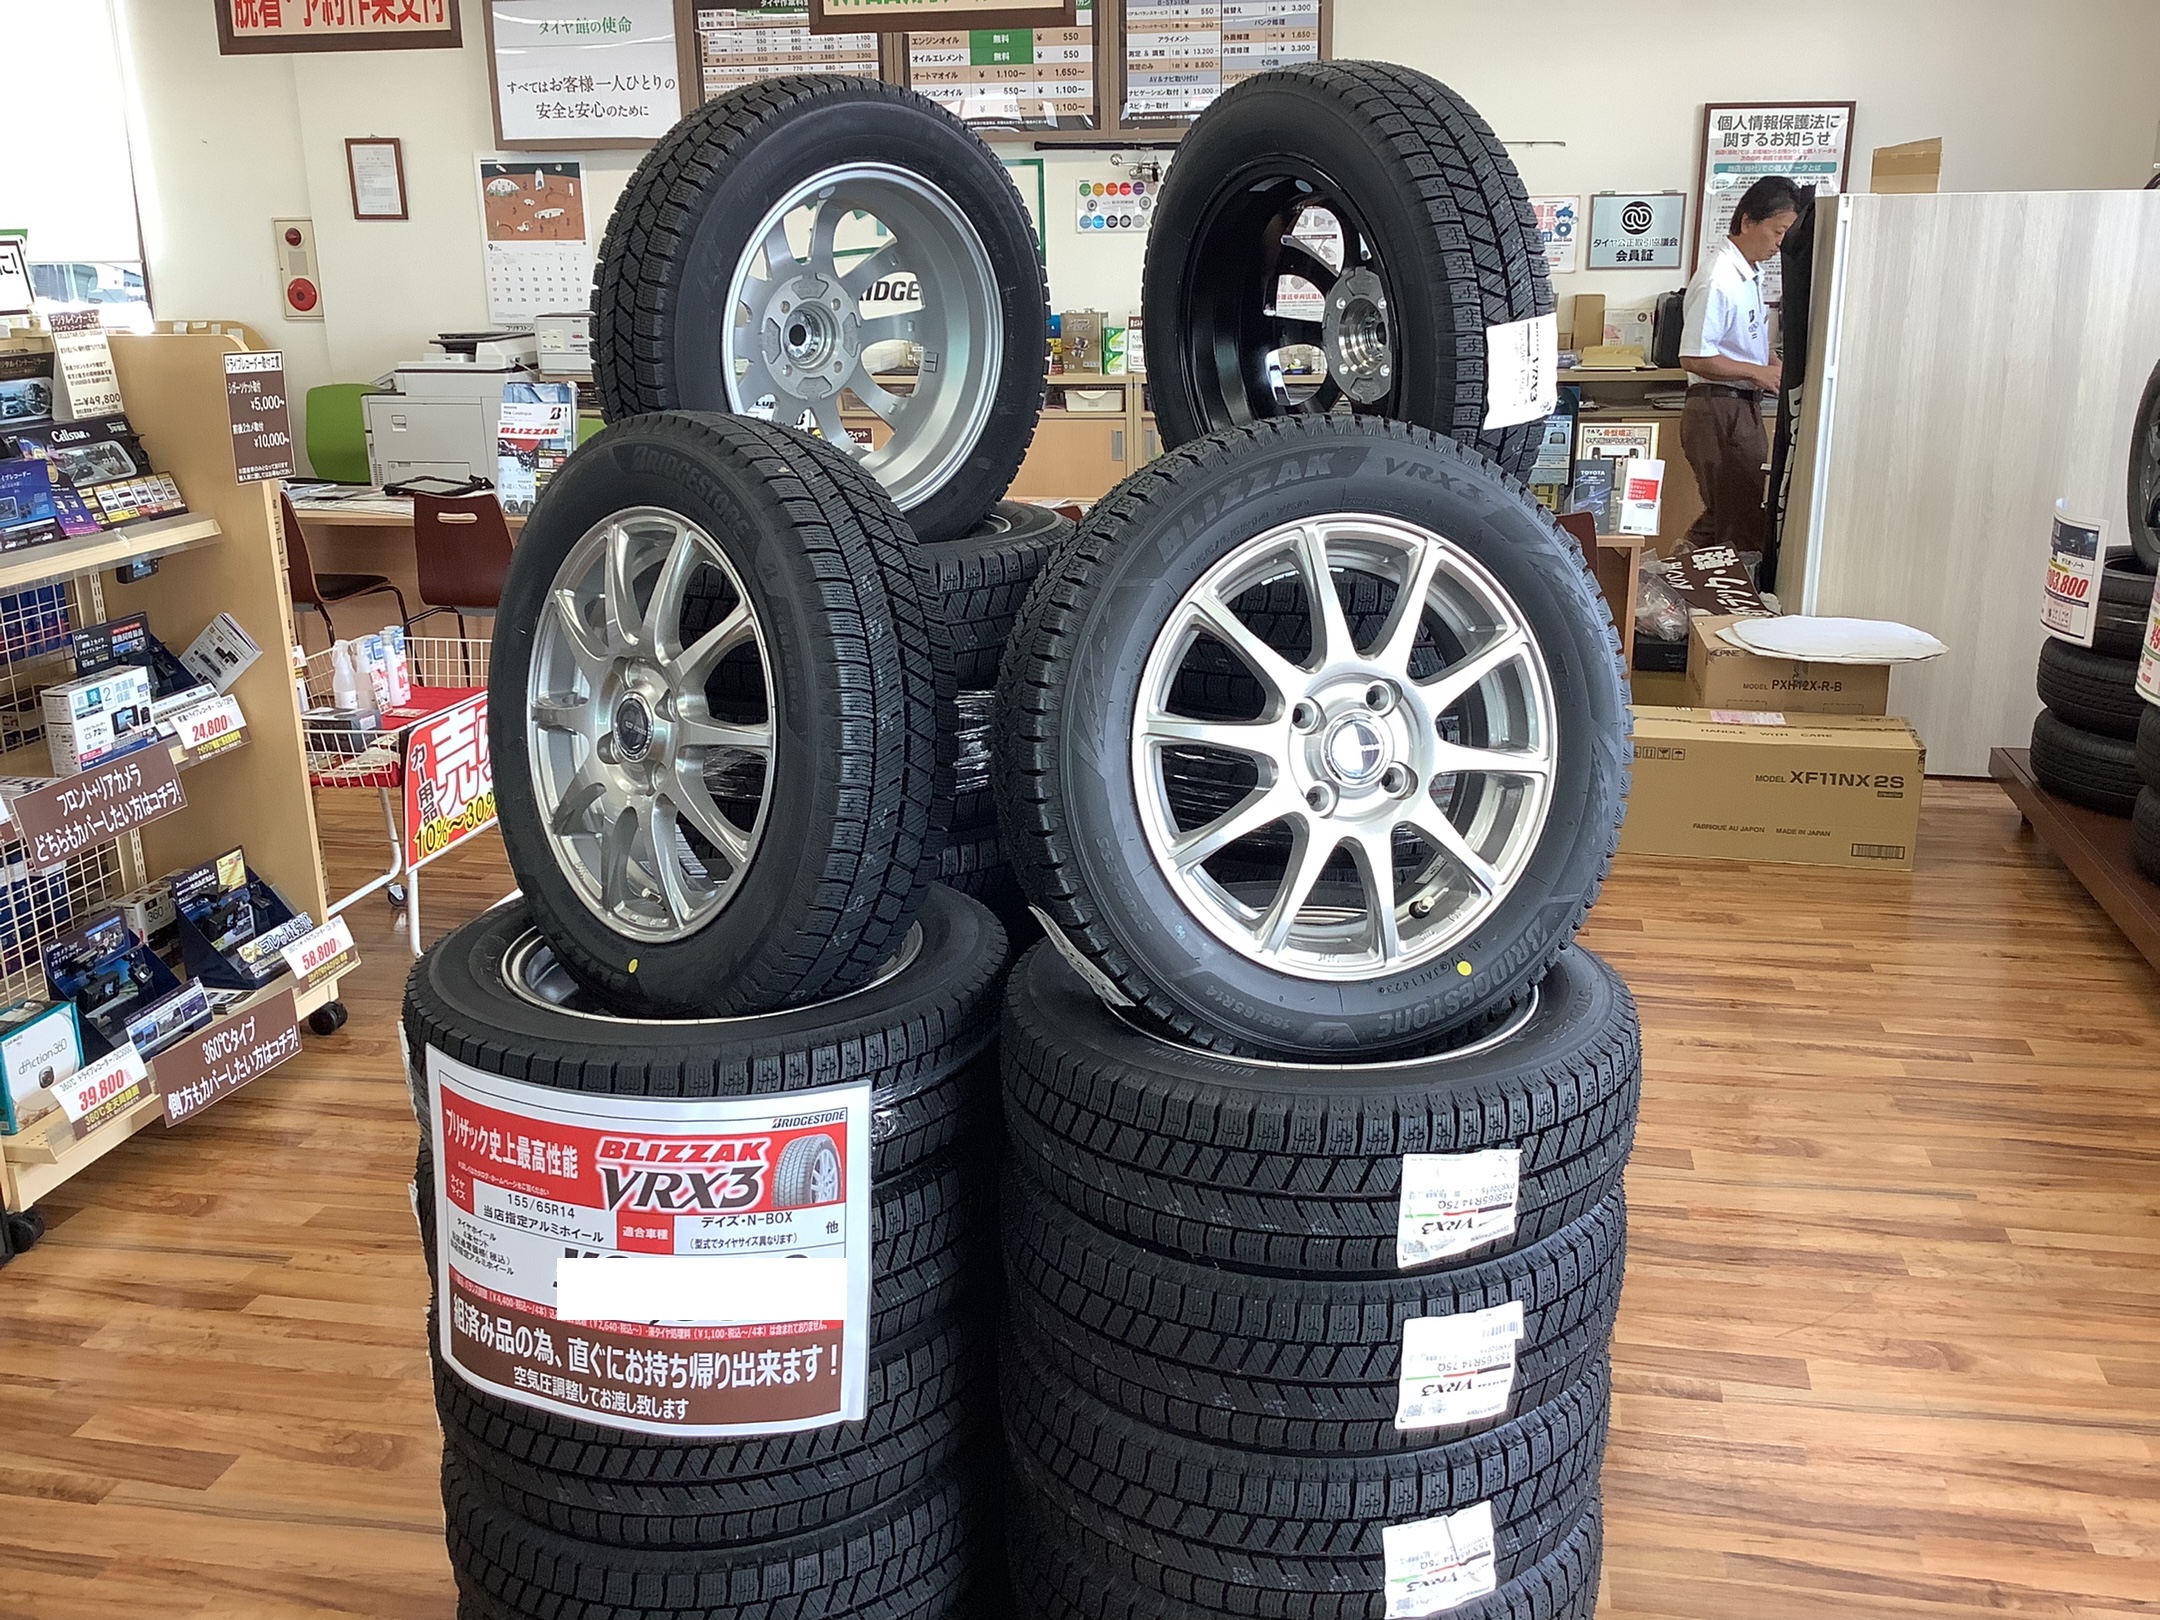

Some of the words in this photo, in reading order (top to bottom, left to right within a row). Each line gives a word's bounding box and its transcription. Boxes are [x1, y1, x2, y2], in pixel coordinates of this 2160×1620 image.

[539, 16, 633, 35] タイヤ館の使命
[911, 35, 960, 46] エンジンオイル
[992, 34, 1010, 44] 無料
[1063, 33, 1079, 41] 550
[1158, 35, 1190, 43] アライメント
[912, 53, 965, 63] オイルエレメント
[993, 51, 1010, 61] 無料
[1063, 51, 1080, 59] 550
[1152, 49, 1165, 57] 調整
[913, 71, 959, 80] オートマオイル
[1129, 62, 1154, 70] 測定のみ
[506, 75, 676, 95] すべてはお客様一人ひとりの
[1129, 88, 1180, 97] ナビゲーション取付
[536, 101, 650, 120] 安全と安心のために
[1717, 114, 1840, 131] 個人情報保護法に
[1723, 132, 1831, 148] 関するお知らせ
[488, 243, 494, 251] 9
[1593, 238, 1678, 248] タイヤ公正取引協議会
[1616, 249, 1654, 262] 会員証
[860, 281, 920, 301] IDGE
[1529, 357, 1539, 402] VRX3
[83, 393, 121, 406] ¥49,800
[500, 427, 559, 435] BLIZZAK
[1383, 456, 1484, 501] VRX3
[631, 445, 750, 541] BRIDGESTONE
[1156, 452, 1335, 563] BLIZZAK
[103, 687, 112, 702] 2
[1743, 682, 1768, 691] MODEL
[192, 714, 228, 742] 24,800
[1755, 774, 1786, 784] MODEL
[57, 762, 142, 817] フロント+リアカメラ
[35, 778, 182, 863] どちらもカバーしたい方はコチラ!
[1740, 826, 1765, 834] JAPON
[147, 905, 163, 923] 360
[302, 938, 337, 970] 58,800
[1378, 916, 1550, 1039] BRIDGESTONE
[168, 1024, 299, 1120] 側方もカバーしたい方はコチラ!
[79, 1069, 125, 1112] 39,800
[771, 1110, 846, 1130] BRIDGESTONE
[445, 1108, 579, 1180] ブリザック史上最高性能
[598, 1139, 769, 1163] BLIZZAK
[450, 1174, 466, 1189] タイヤ
[599, 1165, 765, 1212] VRX3
[450, 1184, 466, 1201] サイズ
[507, 1193, 576, 1219] 155/65R14
[1437, 1200, 1460, 1210] 75Q
[457, 1218, 496, 1242] タイヤホイール
[483, 1204, 604, 1243] 当店指定アルミホイール
[701, 1211, 793, 1229] デイズ・N-BOX
[826, 1221, 840, 1235] 他
[1421, 1216, 1473, 1236] VRX3
[622, 1225, 669, 1241] 適合車種
[1437, 1362, 1458, 1372] 75Q
[513, 1365, 690, 1421] 空気圧調整してお渡し致します
[1420, 1378, 1473, 1397] VRX3
